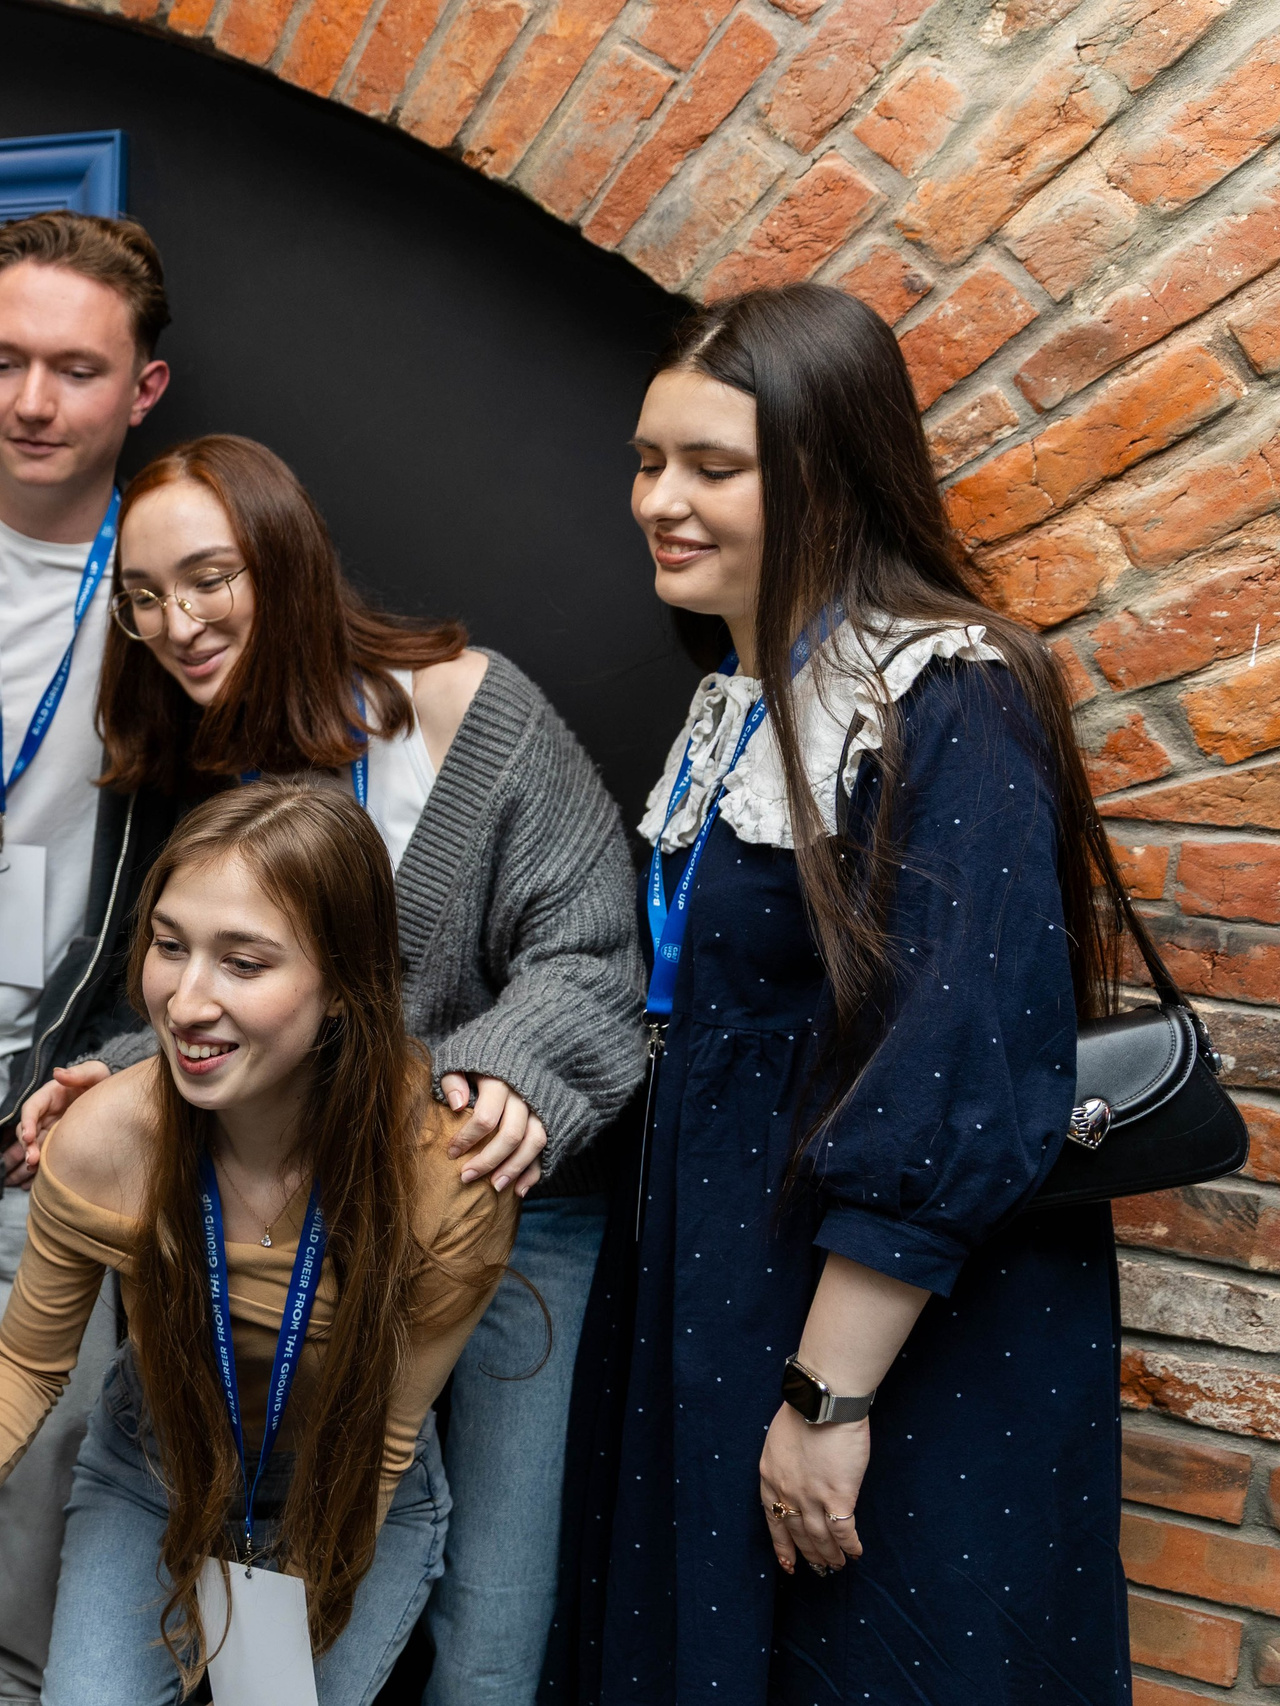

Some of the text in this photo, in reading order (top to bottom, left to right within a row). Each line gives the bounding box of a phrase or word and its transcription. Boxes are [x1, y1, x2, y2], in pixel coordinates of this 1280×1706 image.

[677, 893, 686, 910] UP
[202, 1193, 213, 1212] UP
[205, 1215, 218, 1269] GROUND
[210, 1273, 220, 1300] THE
[299, 1246, 316, 1289] CAREER
[212, 1304, 226, 1342] FROM
[289, 1292, 306, 1331] FROM
[283, 1334, 297, 1359] THE
[220, 1346, 232, 1387] CAREER
[274, 1362, 290, 1412] GROUND
[271, 1414, 280, 1431] UP
